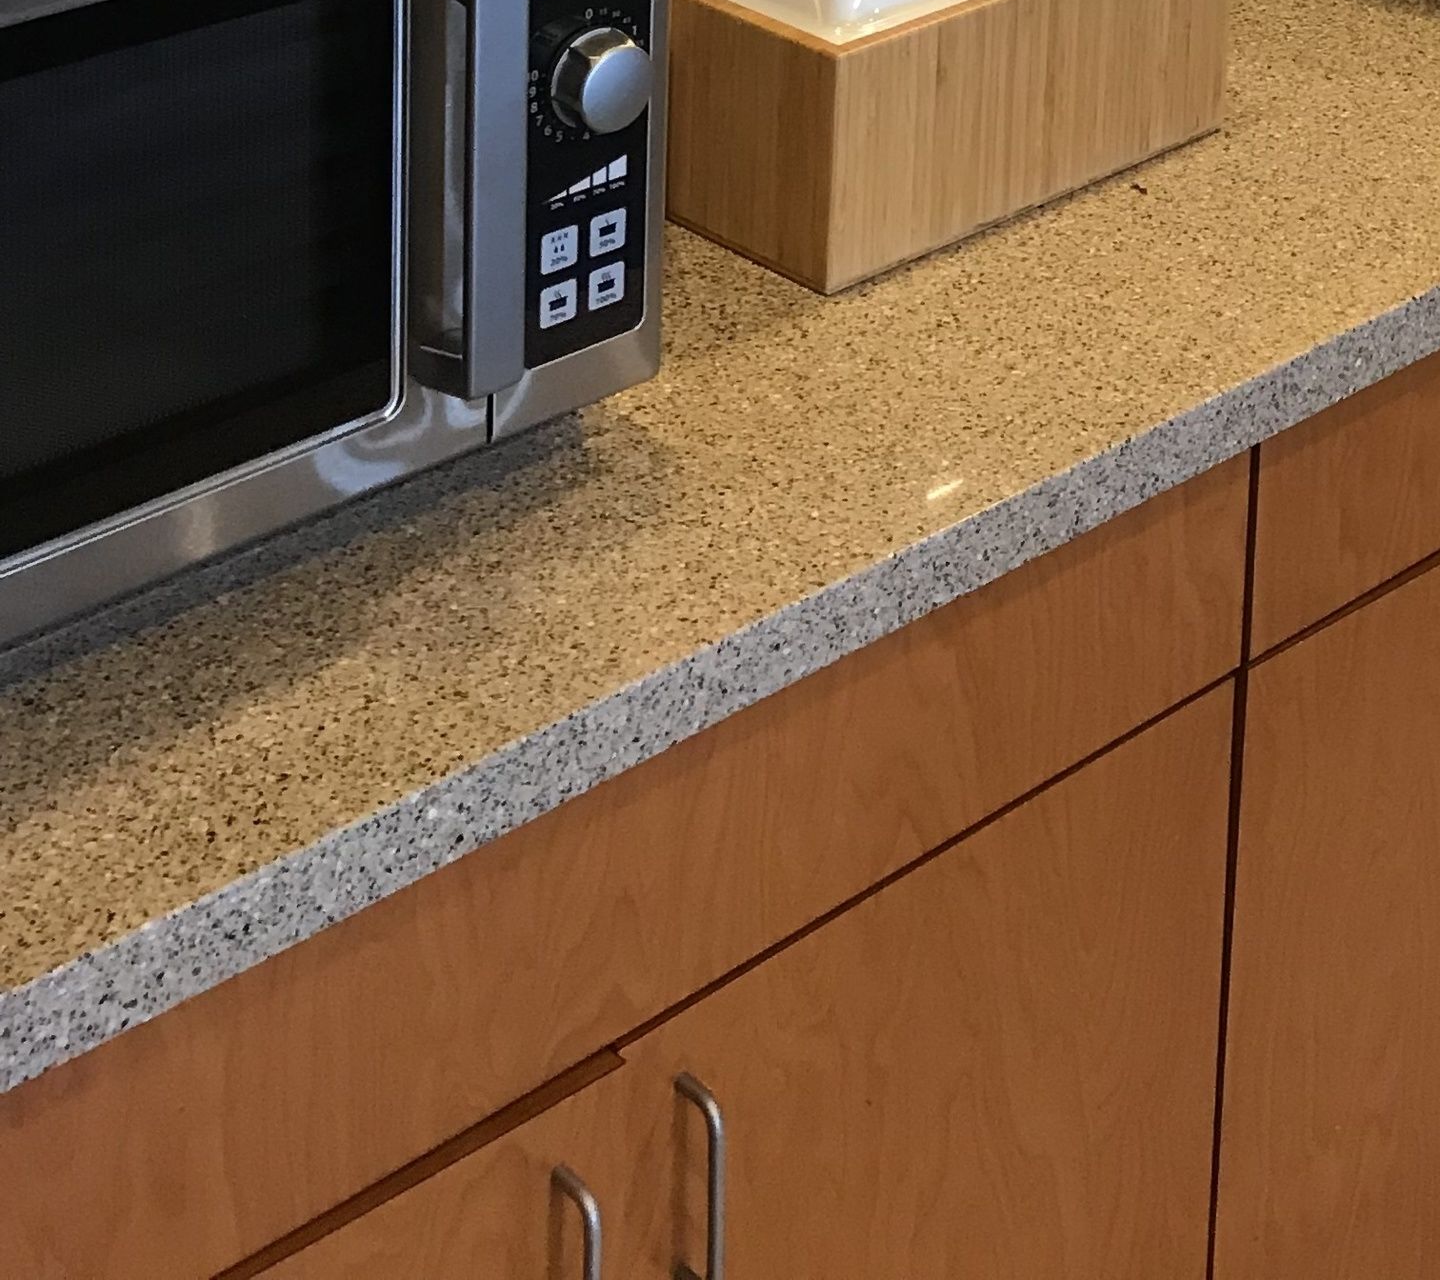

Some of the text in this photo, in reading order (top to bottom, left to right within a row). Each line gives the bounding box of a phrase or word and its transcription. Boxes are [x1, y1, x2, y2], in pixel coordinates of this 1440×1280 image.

[585, 7, 594, 20] 0
[528, 86, 537, 98] 9
[530, 101, 538, 114] 8
[535, 114, 544, 127] 7
[543, 125, 553, 137] 6
[555, 130, 564, 143] 5
